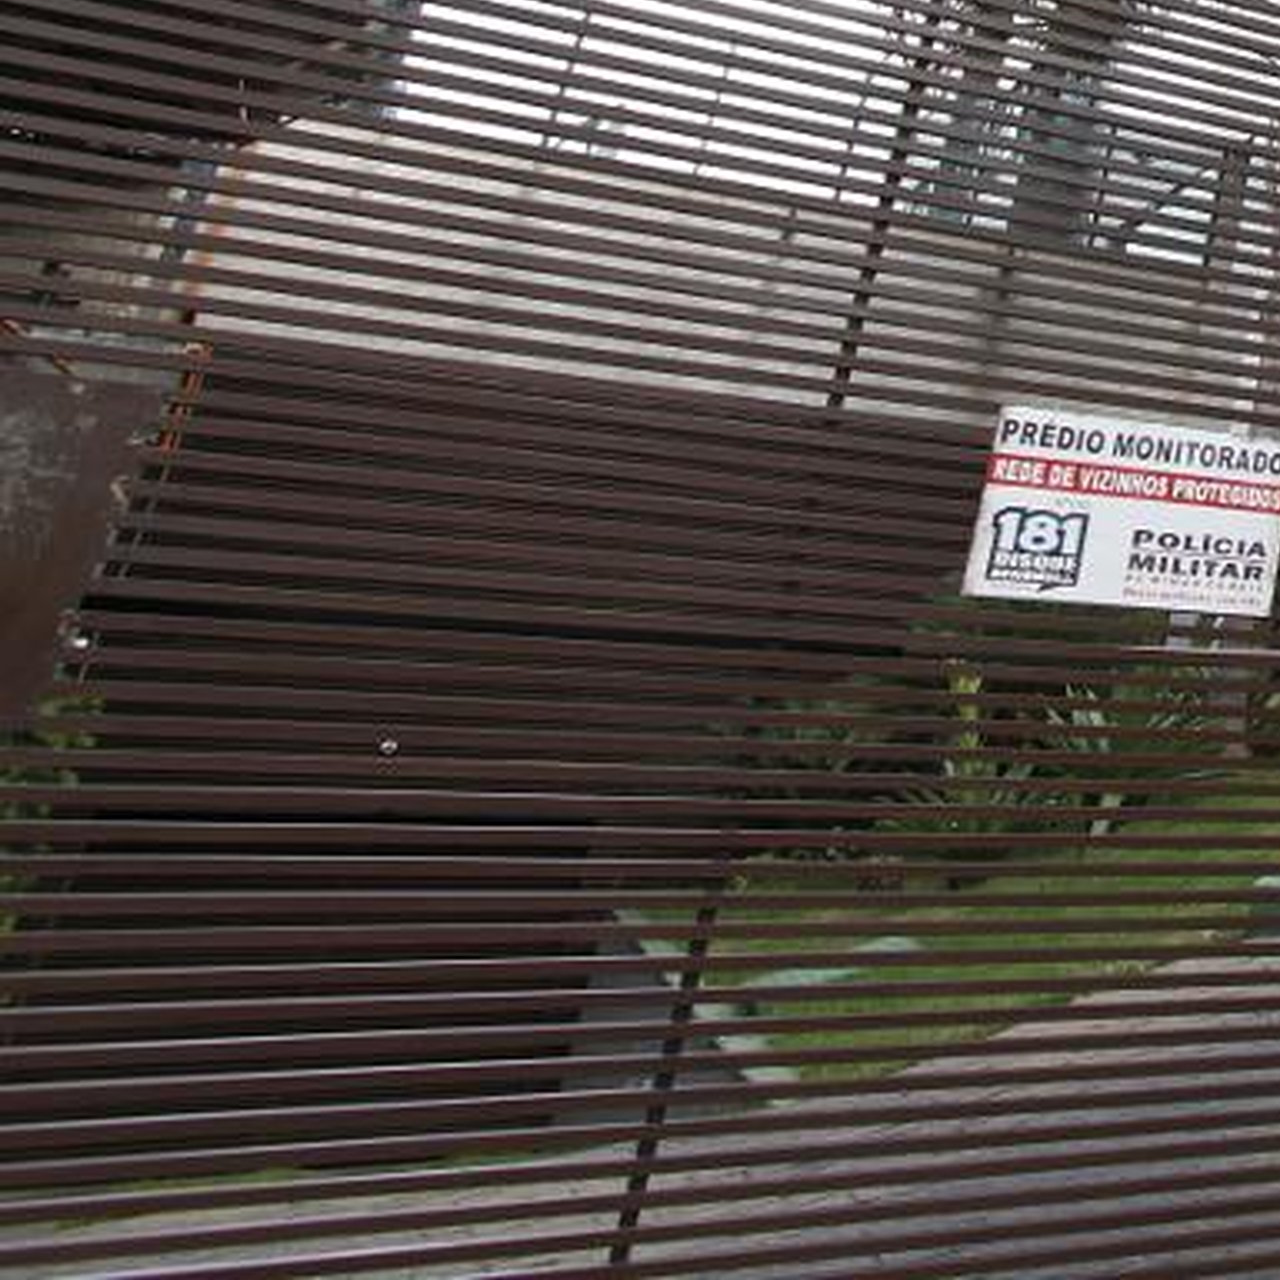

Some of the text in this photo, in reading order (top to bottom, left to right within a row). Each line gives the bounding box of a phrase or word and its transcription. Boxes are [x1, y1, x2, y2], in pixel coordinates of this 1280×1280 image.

[993, 458, 1047, 485] REDE
[1050, 463, 1077, 488] DE
[1080, 467, 1168, 497] VIZINHOS
[994, 507, 1088, 554] 181
[1128, 554, 1264, 581] MILITAR
